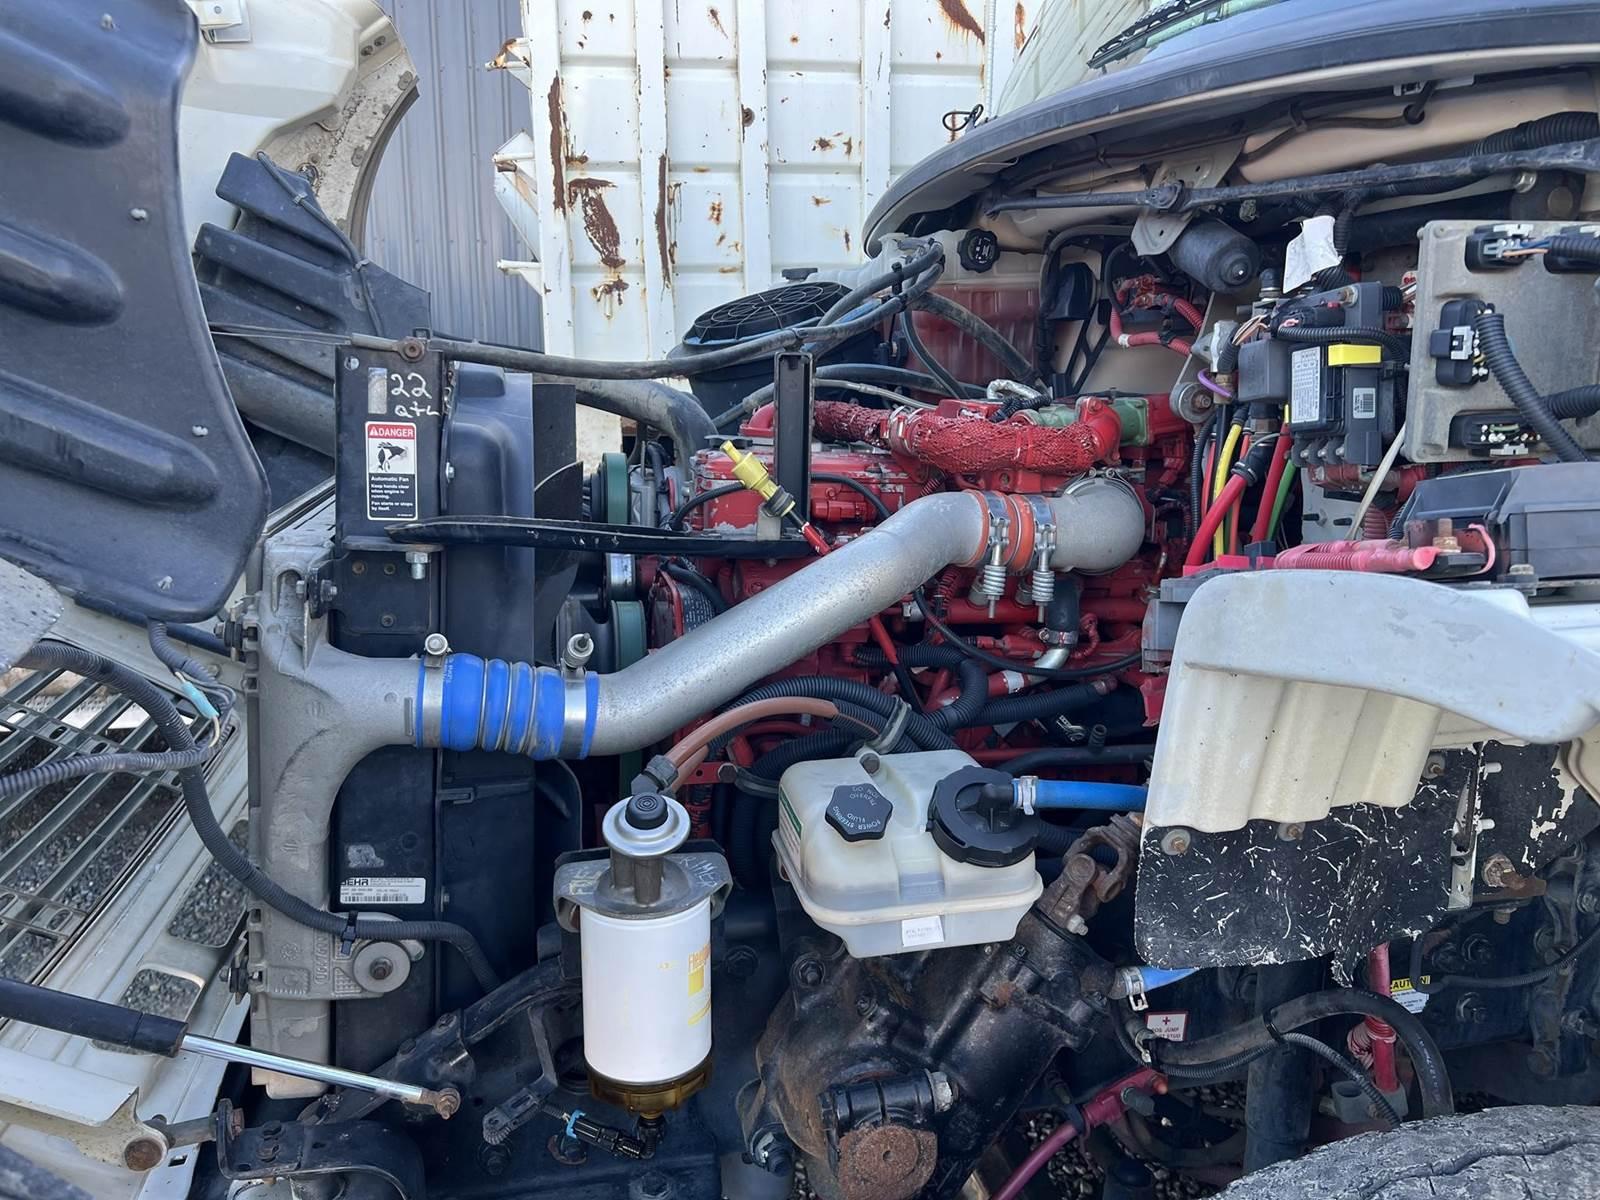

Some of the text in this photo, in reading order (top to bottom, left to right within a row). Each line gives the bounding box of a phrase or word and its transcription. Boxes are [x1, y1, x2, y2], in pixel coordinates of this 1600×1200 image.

[390, 372, 433, 399] 22
[378, 427, 415, 438] DANGER
[832, 806, 881, 830] POWER STEERING
[847, 813, 866, 824] FLUID
